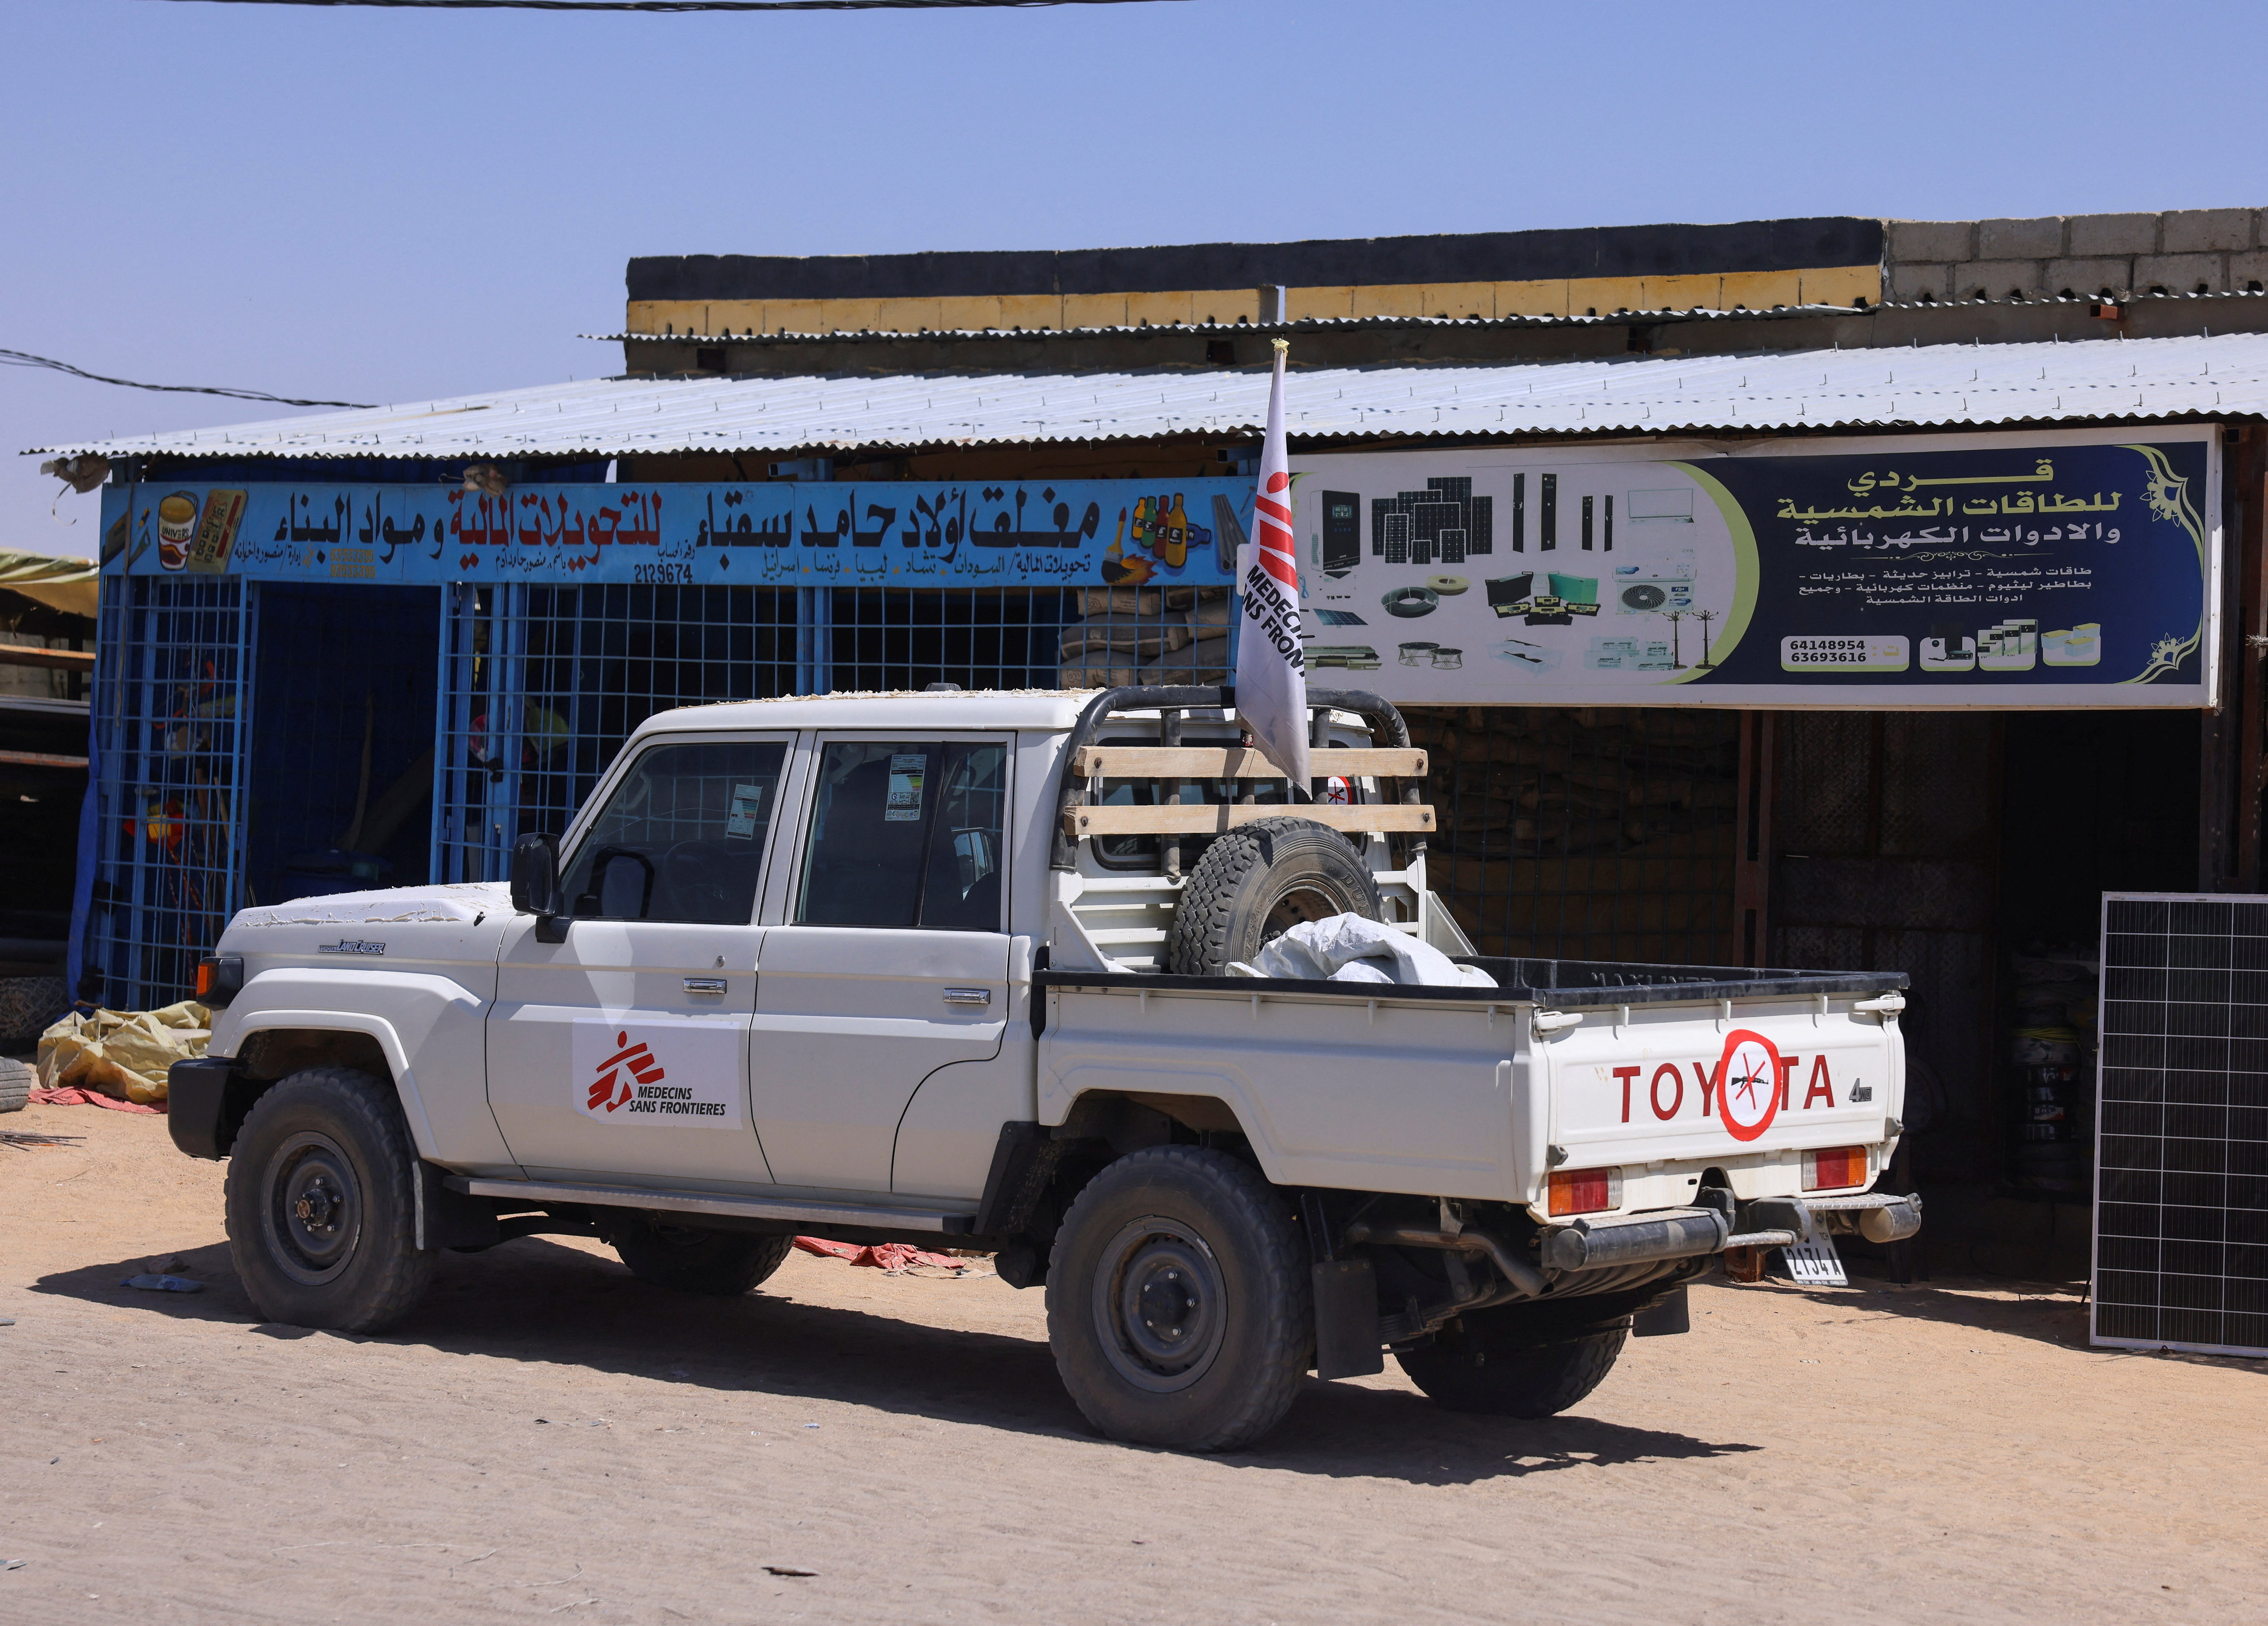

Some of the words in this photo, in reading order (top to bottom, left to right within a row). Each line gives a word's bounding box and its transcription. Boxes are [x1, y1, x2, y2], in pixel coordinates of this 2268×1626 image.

[1776, 495, 1953, 524] الشمسية
[1962, 491, 2122, 515] للطاقات
[801, 489, 896, 547] حامد
[902, 487, 966, 564] أولاد
[969, 484, 1100, 549] مغلق
[273, 491, 351, 564] البناء
[448, 489, 515, 571] المالية
[519, 490, 662, 573] للتحويلات
[1795, 525, 1969, 549] الكهربائية
[1980, 521, 2121, 546] والادوات
[259, 544, 284, 564] منصور
[657, 540, 682, 563] الحساب
[680, 539, 695, 560] رقم
[523, 551, 546, 573] منصور
[814, 550, 840, 580] فرنسا
[855, 552, 887, 581] ليبيا
[906, 550, 936, 574] تشاد
[954, 551, 1005, 578] السودان
[1016, 552, 1043, 580] المالية
[1044, 554, 1091, 580] تحويلات
[1986, 567, 2042, 578] شمسية
[2045, 567, 2092, 576] طاقات
[634, 563, 693, 584] 2129674
[1809, 572, 1865, 581] بطاريات
[1883, 570, 1928, 580] حديثة
[1931, 569, 1971, 579] ترابيز
[1798, 586, 1841, 595] وجميع
[1856, 583, 1914, 593] كهربائية
[1917, 582, 1973, 591] منظمات
[1988, 580, 2034, 592] ليثيوم
[2037, 580, 2092, 590] بطاطير
[1866, 595, 1931, 605] الشمسية
[1934, 594, 1982, 603] الطاقة
[1985, 594, 2023, 603] ادوات
[1790, 640, 1865, 650] 64148954
[1791, 652, 1866, 662] 63693616
[638, 1086, 693, 1100] MEDECINS
[1612, 1054, 1835, 1123] TOYTA
[629, 1100, 656, 1113] SANS
[659, 1101, 726, 1116] FRONTIERES
